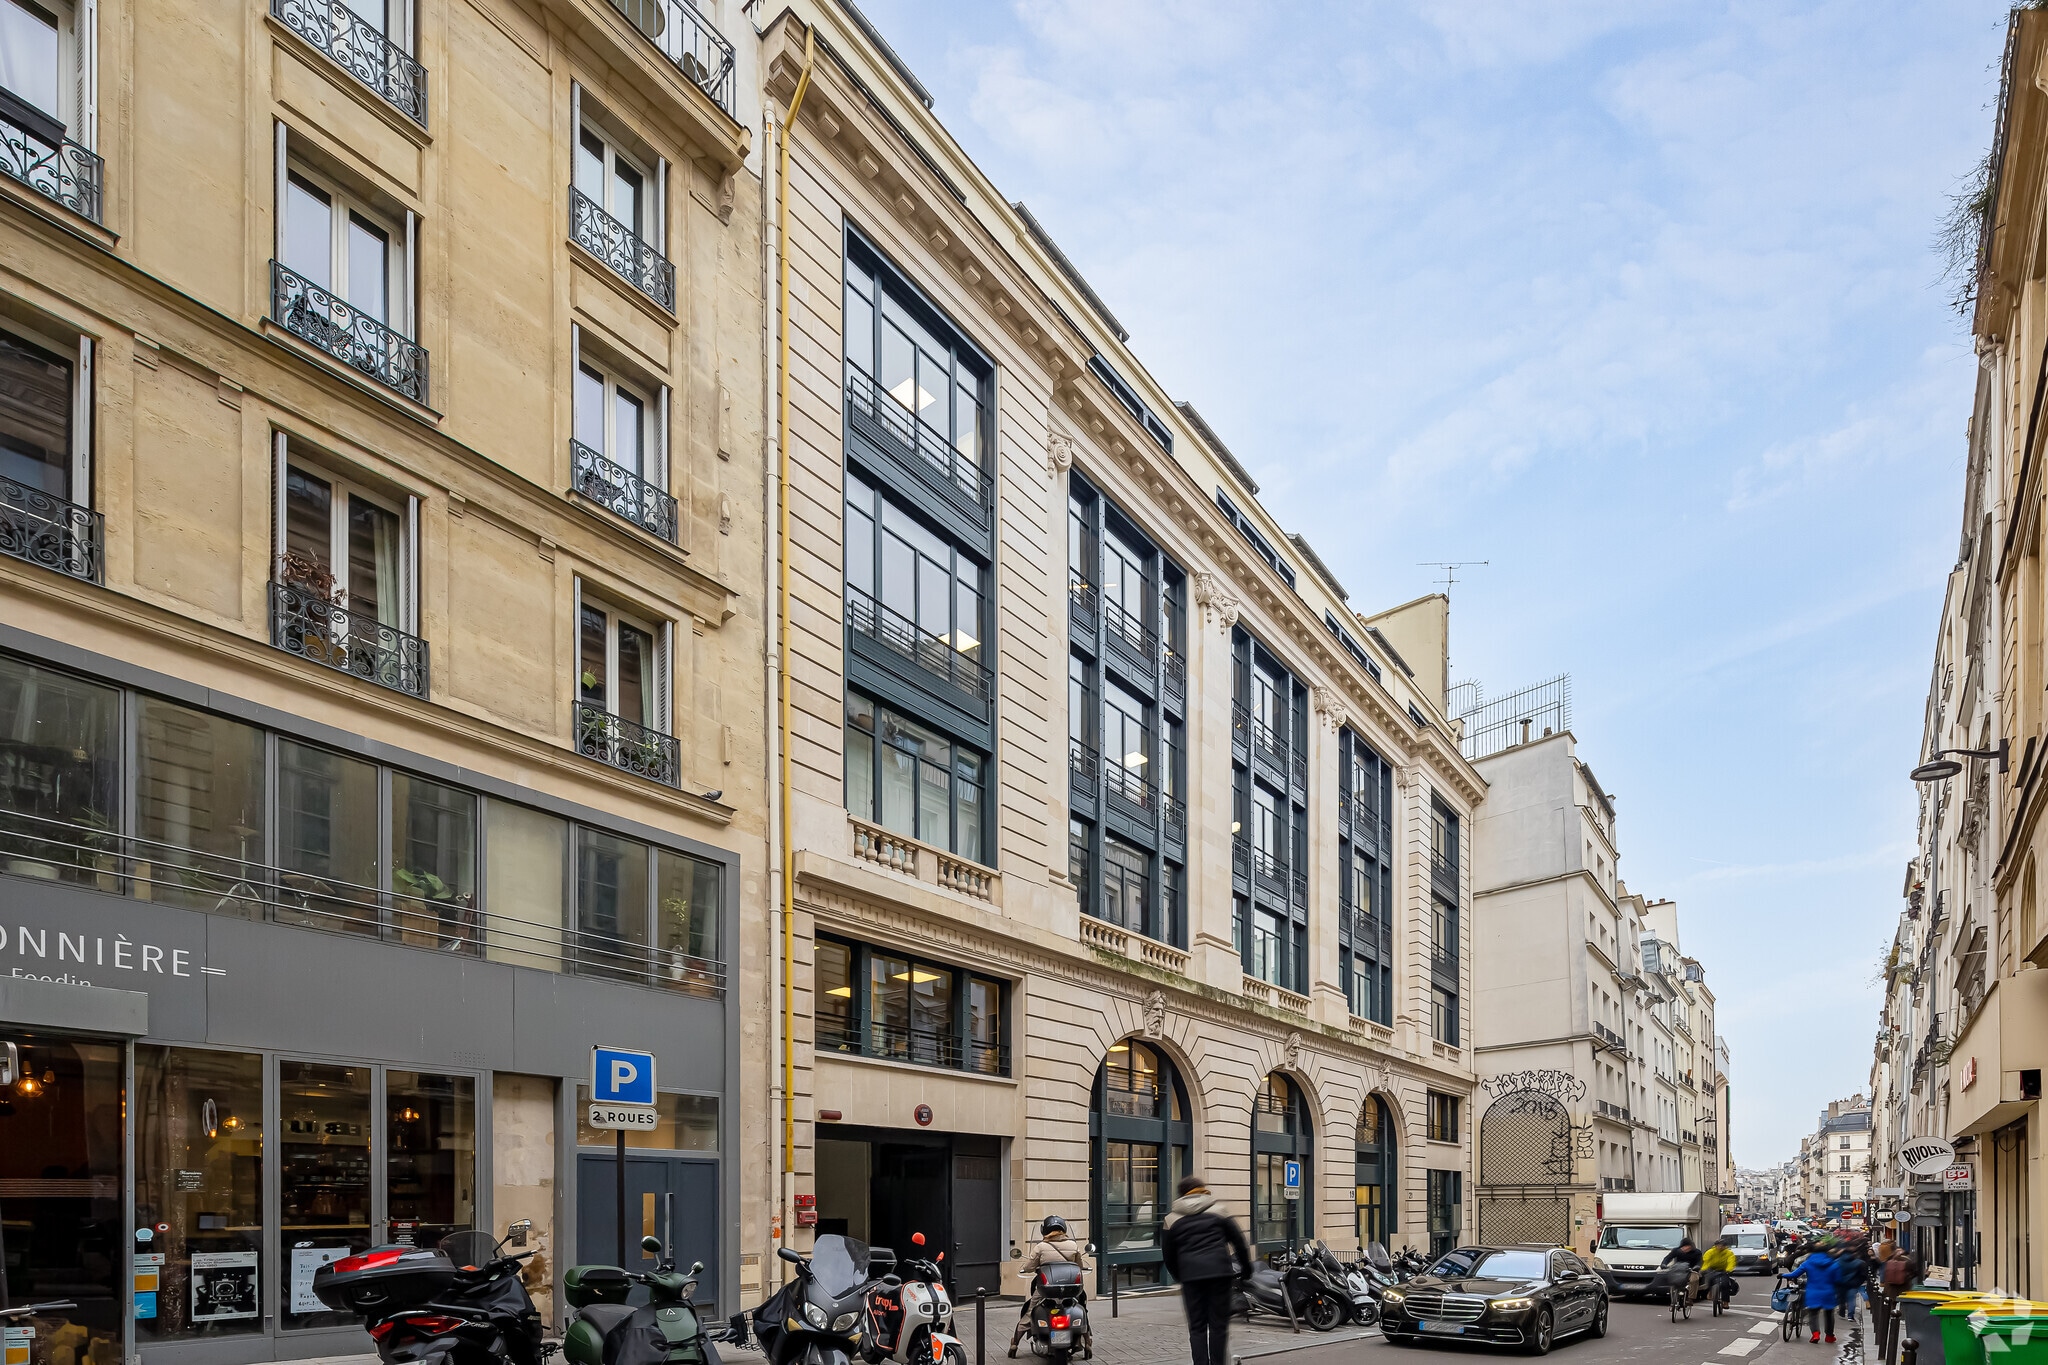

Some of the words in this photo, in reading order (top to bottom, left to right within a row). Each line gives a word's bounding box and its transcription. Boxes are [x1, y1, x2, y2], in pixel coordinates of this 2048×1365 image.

[0, 924, 190, 977] NNIÈRE
[611, 1060, 638, 1093] P
[592, 1111, 601, 1121] 2
[608, 1112, 654, 1124] ROUES
[1289, 1166, 1297, 1182] P
